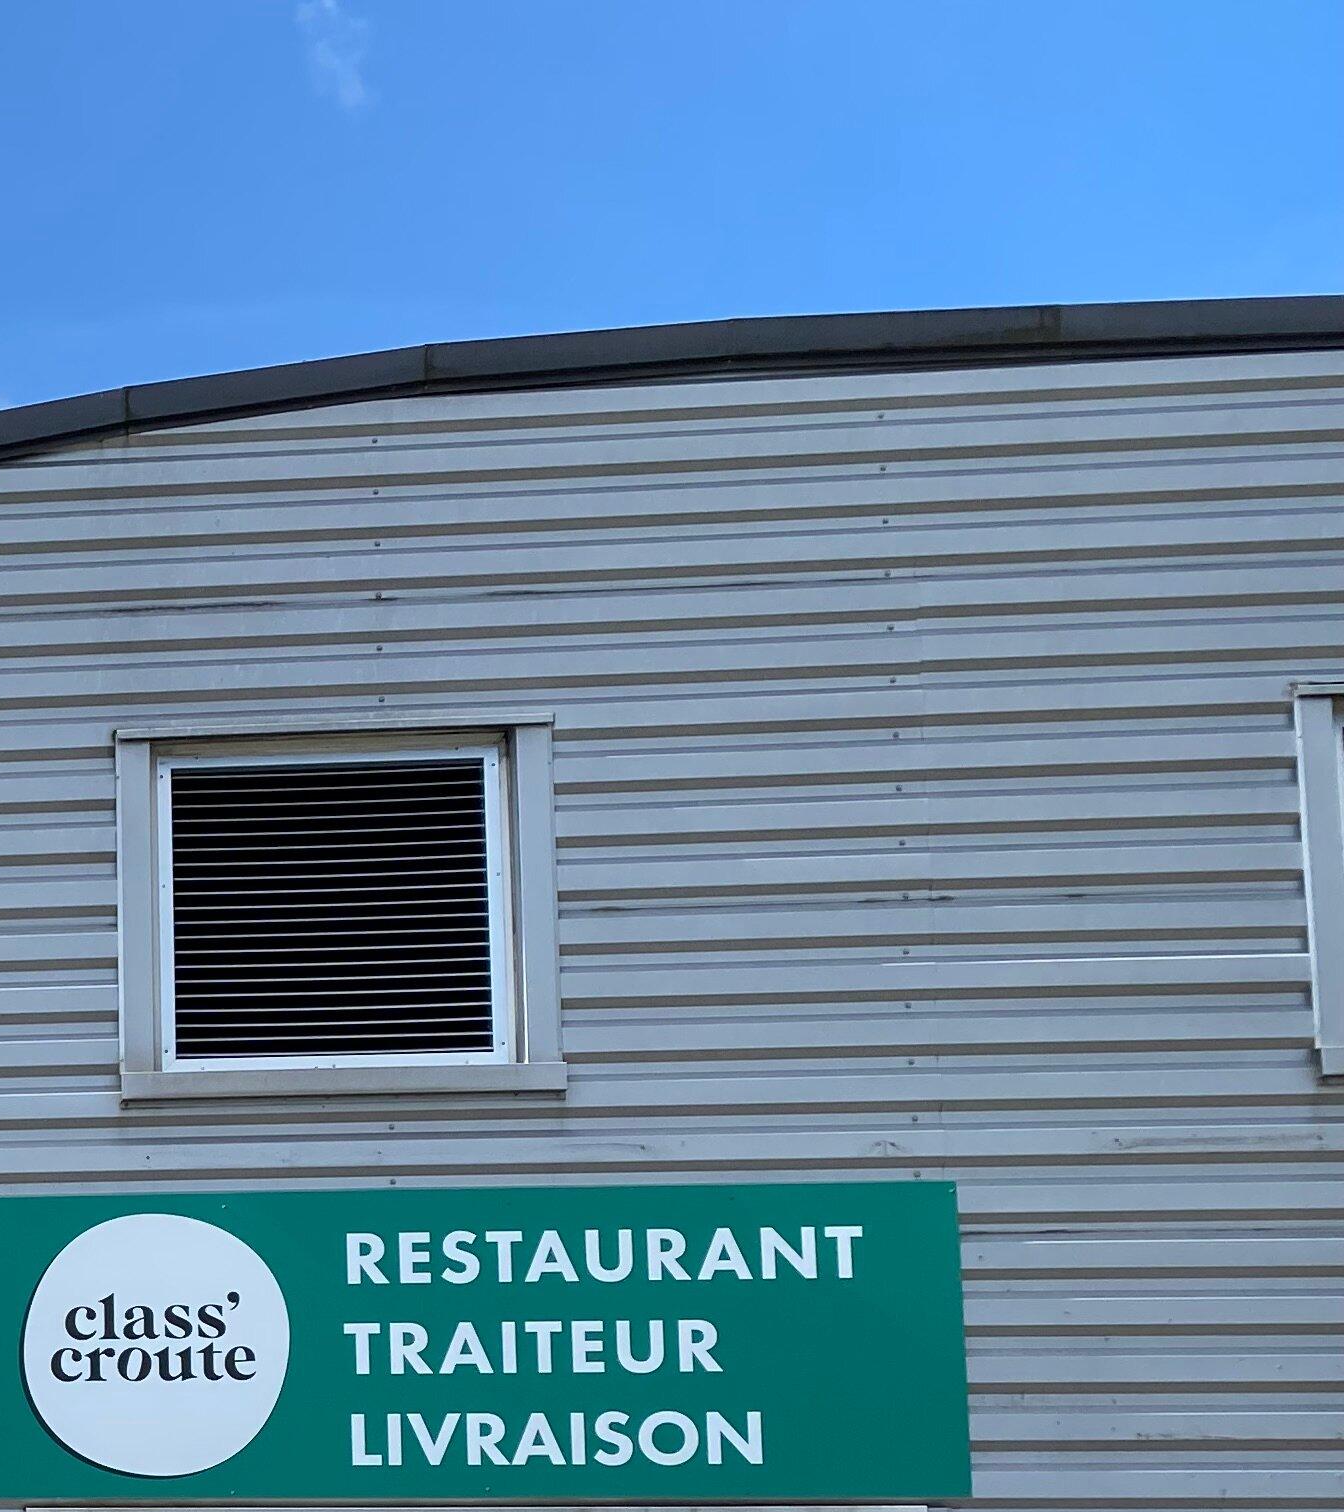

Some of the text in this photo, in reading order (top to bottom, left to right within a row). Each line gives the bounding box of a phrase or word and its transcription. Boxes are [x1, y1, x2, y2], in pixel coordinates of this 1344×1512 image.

[346, 1225, 863, 1285] RESTAURANT
[64, 1291, 240, 1341] class'
[50, 1341, 257, 1383] croute
[343, 1319, 724, 1375] TRAITEUR
[350, 1410, 764, 1467] LIVRAISON
